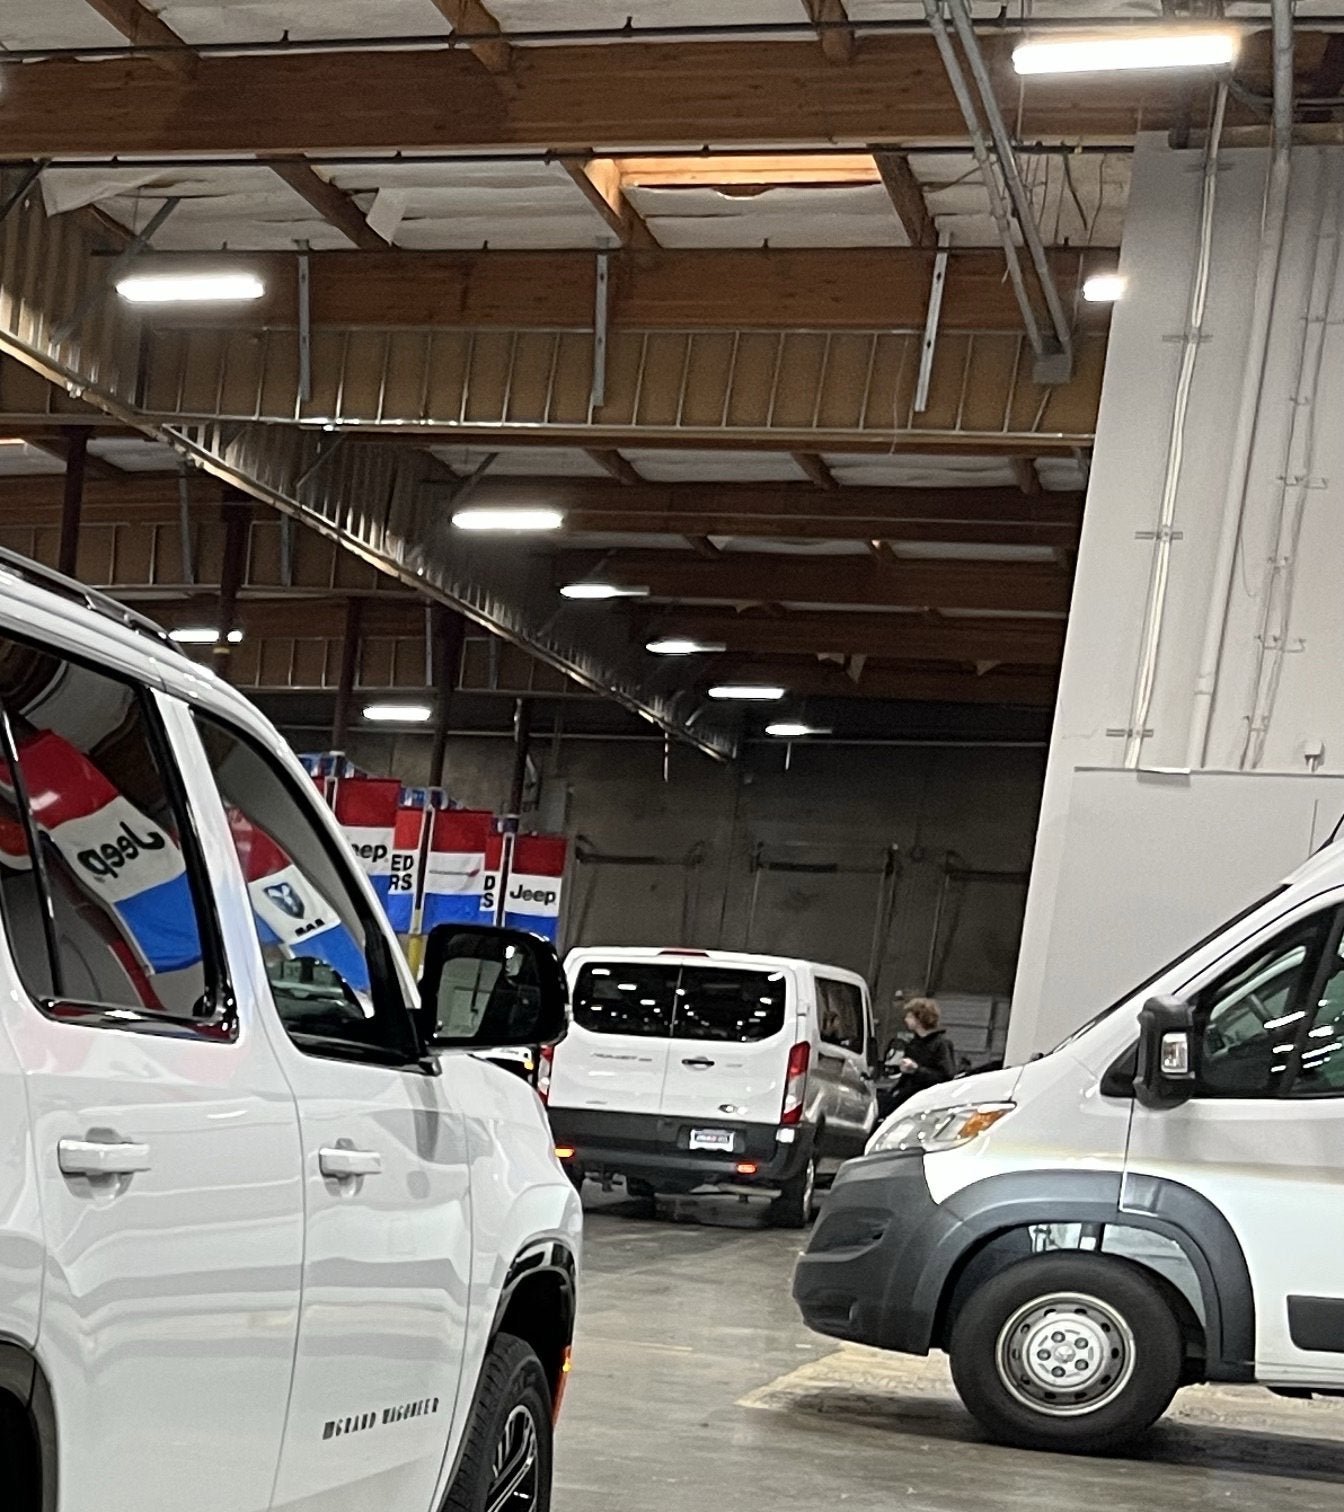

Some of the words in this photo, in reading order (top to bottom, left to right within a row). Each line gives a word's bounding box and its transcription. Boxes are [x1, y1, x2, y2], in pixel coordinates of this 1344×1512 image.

[391, 853, 414, 871] ED
[389, 873, 413, 891] RS
[509, 883, 557, 906] Jeep
